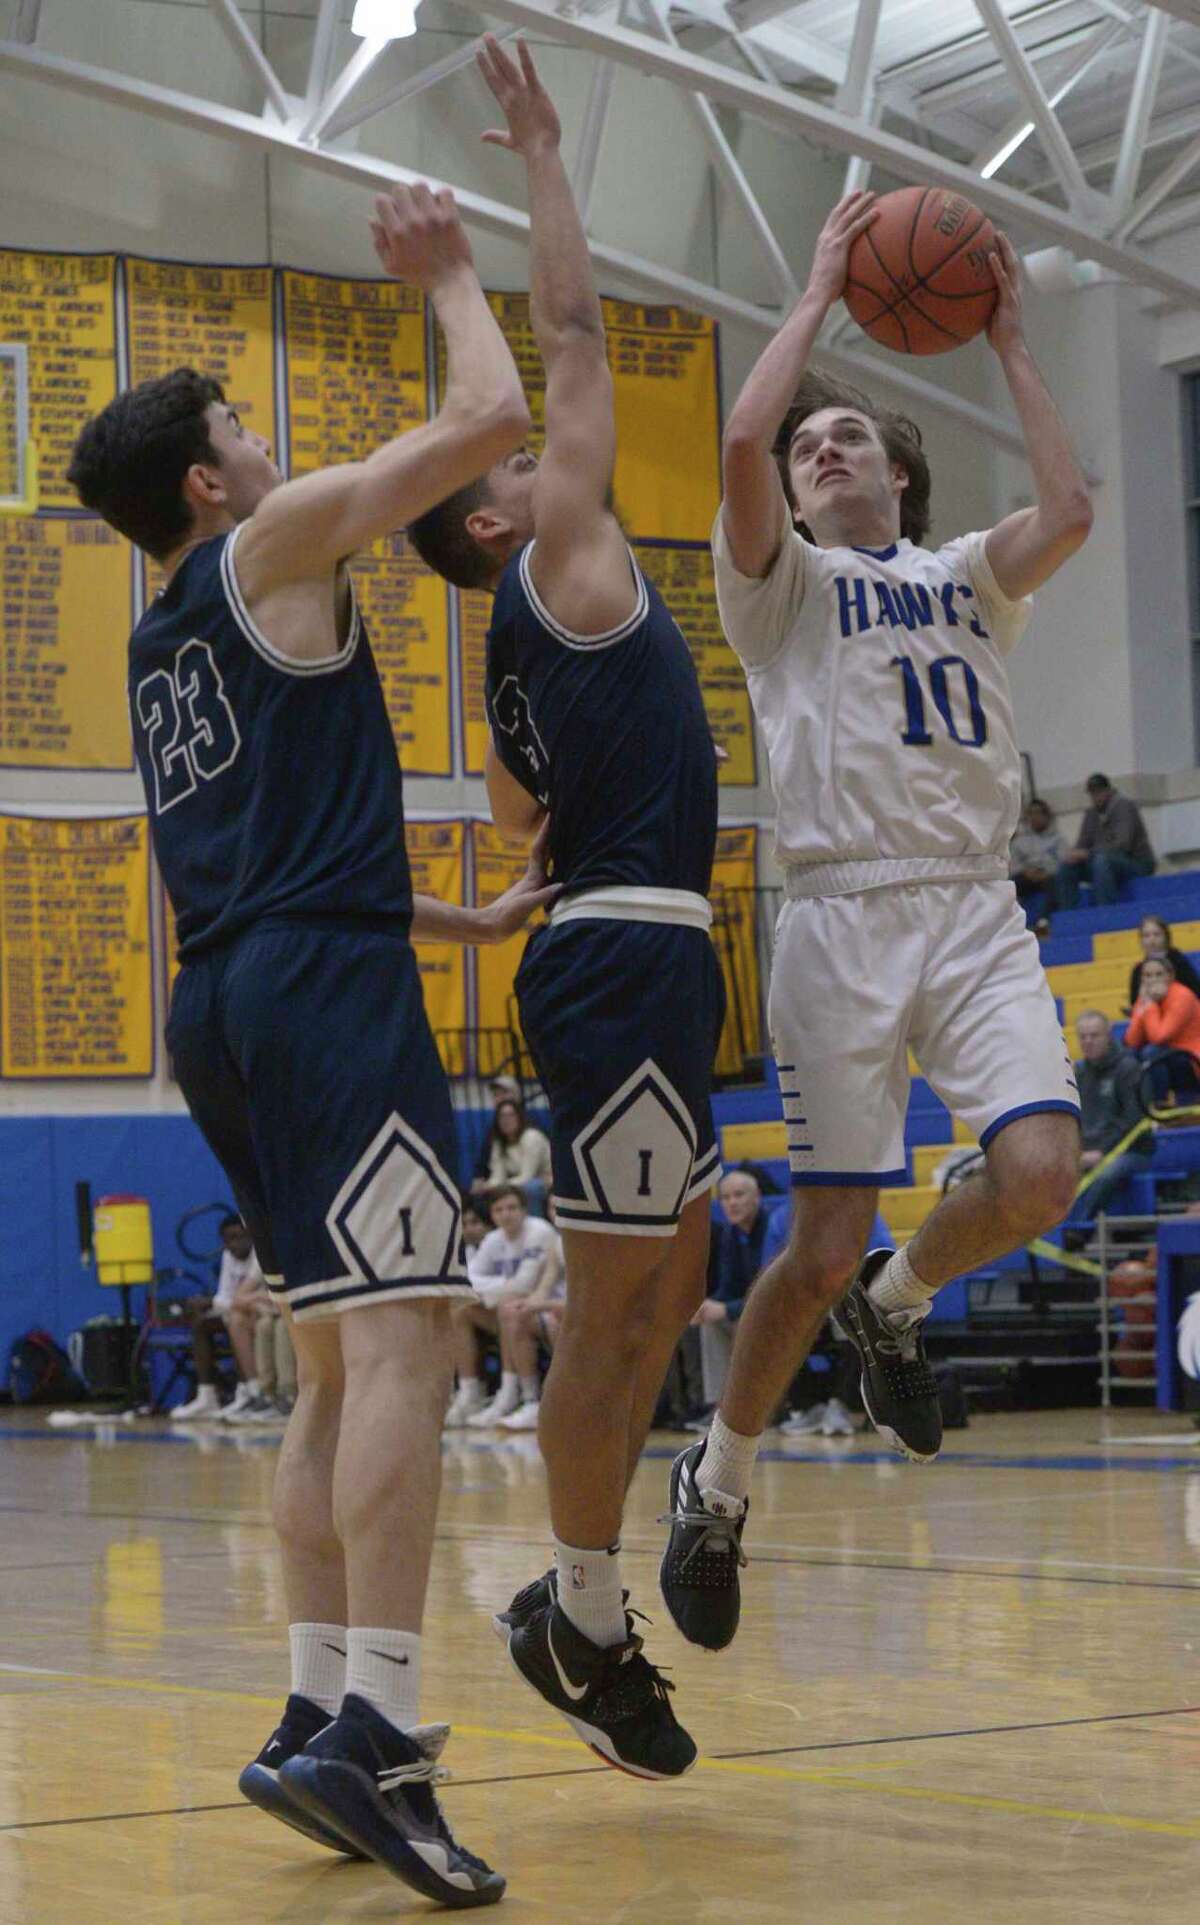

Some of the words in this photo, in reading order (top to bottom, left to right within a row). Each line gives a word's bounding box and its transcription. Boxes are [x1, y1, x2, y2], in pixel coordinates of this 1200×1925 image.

[136, 637, 241, 817] 23
[888, 655, 988, 748] 10
[637, 1149, 654, 1197] I
[398, 1206, 416, 1256] I
